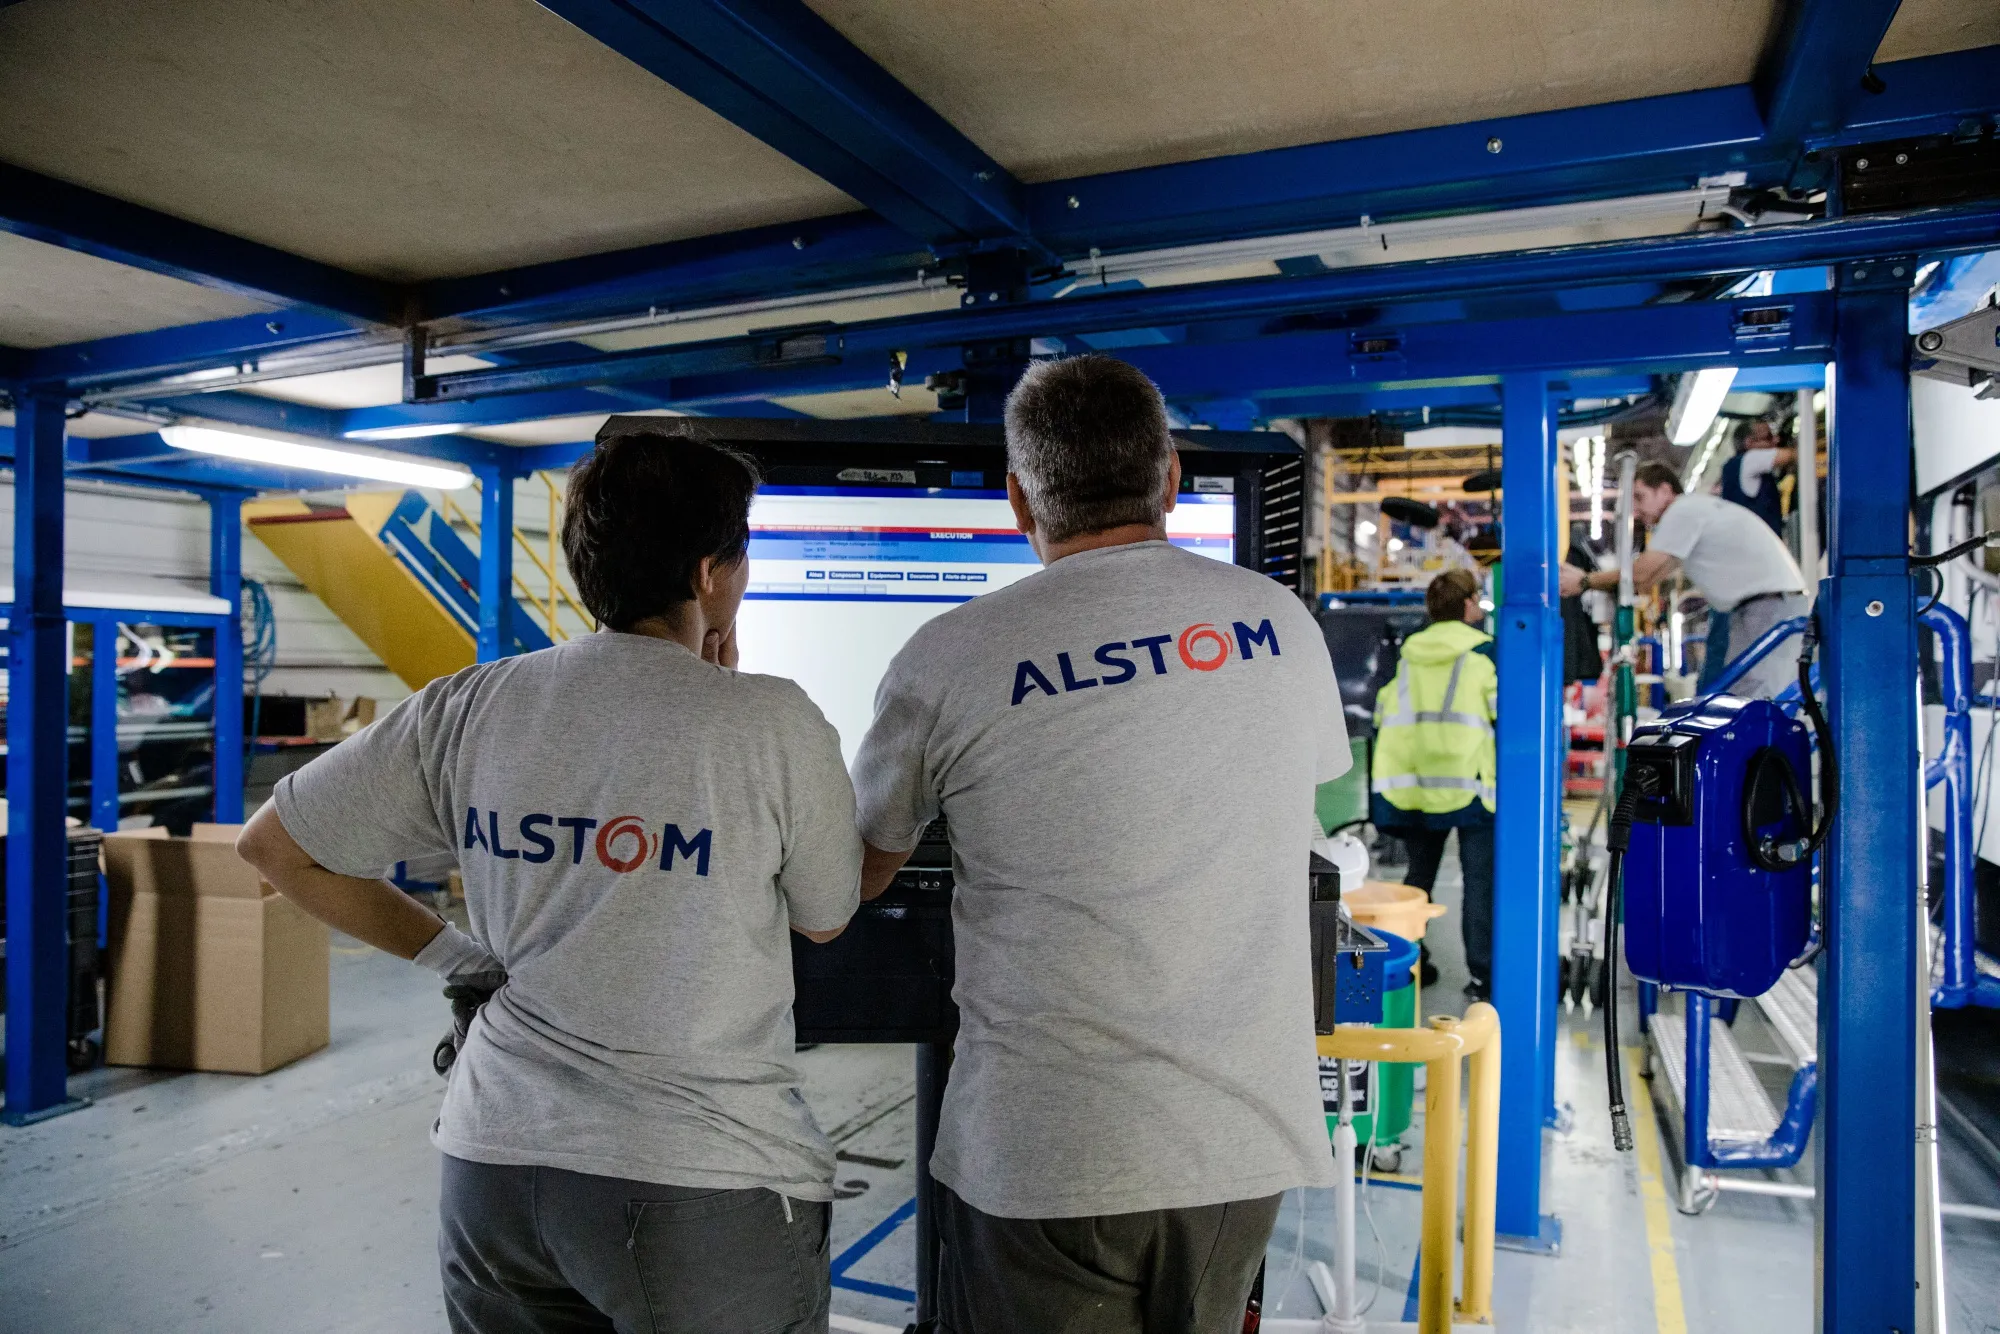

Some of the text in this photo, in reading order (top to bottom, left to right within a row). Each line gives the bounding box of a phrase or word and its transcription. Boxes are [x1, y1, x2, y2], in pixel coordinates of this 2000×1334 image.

[930, 532, 973, 540] EXECUTION
[1011, 619, 1280, 706] ALSTOM
[464, 807, 712, 876] ALSTOM
